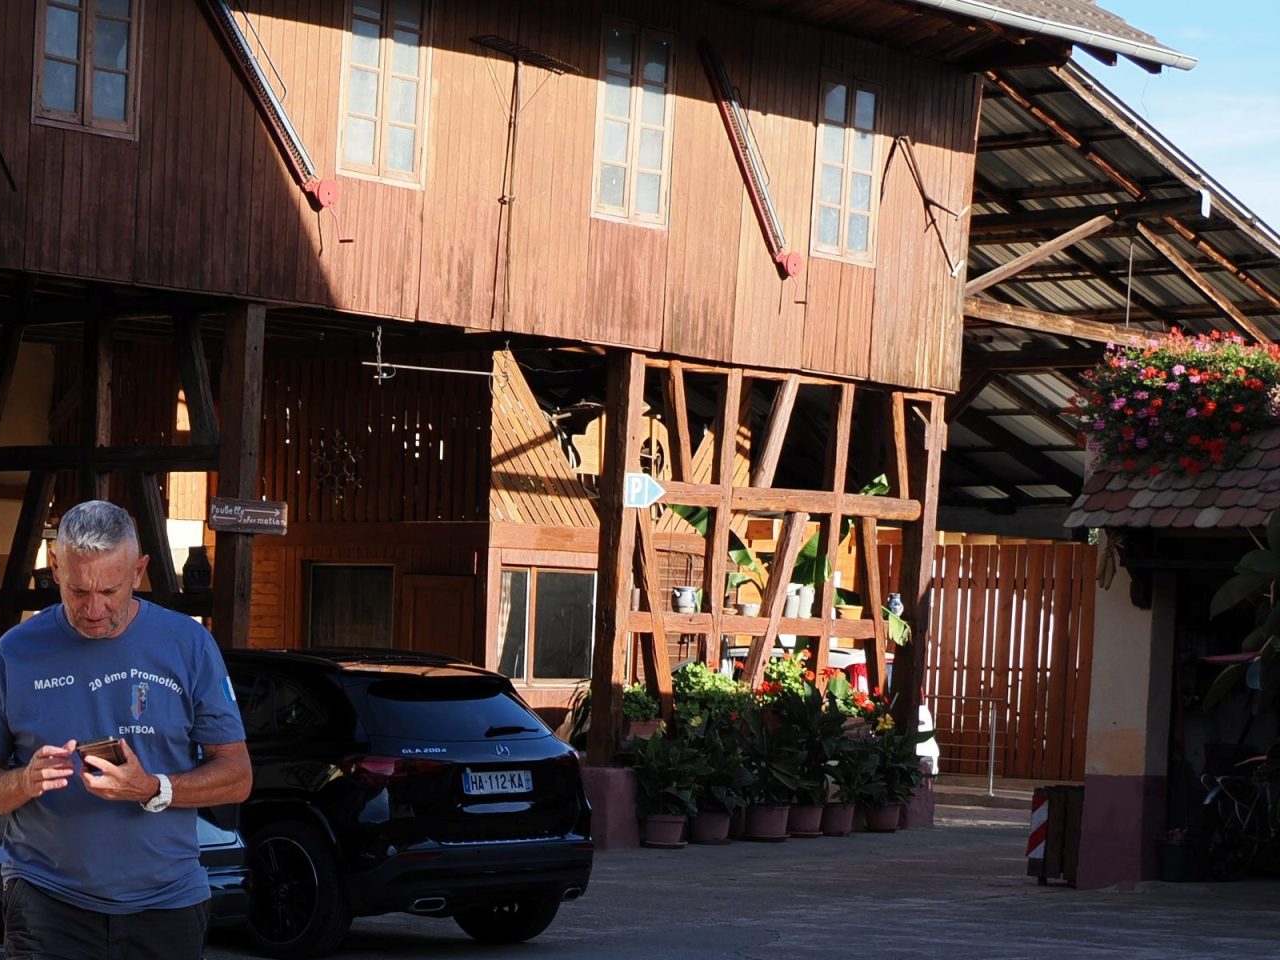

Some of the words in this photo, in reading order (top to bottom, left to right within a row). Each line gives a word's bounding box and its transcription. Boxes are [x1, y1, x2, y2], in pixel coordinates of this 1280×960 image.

[630, 477, 642, 503] P
[34, 675, 75, 690] MARCO
[88, 678, 102, 692] 20
[130, 668, 184, 695] Promotion
[119, 725, 155, 735] ENTSOA
[470, 773, 524, 791] HA-112-KA
